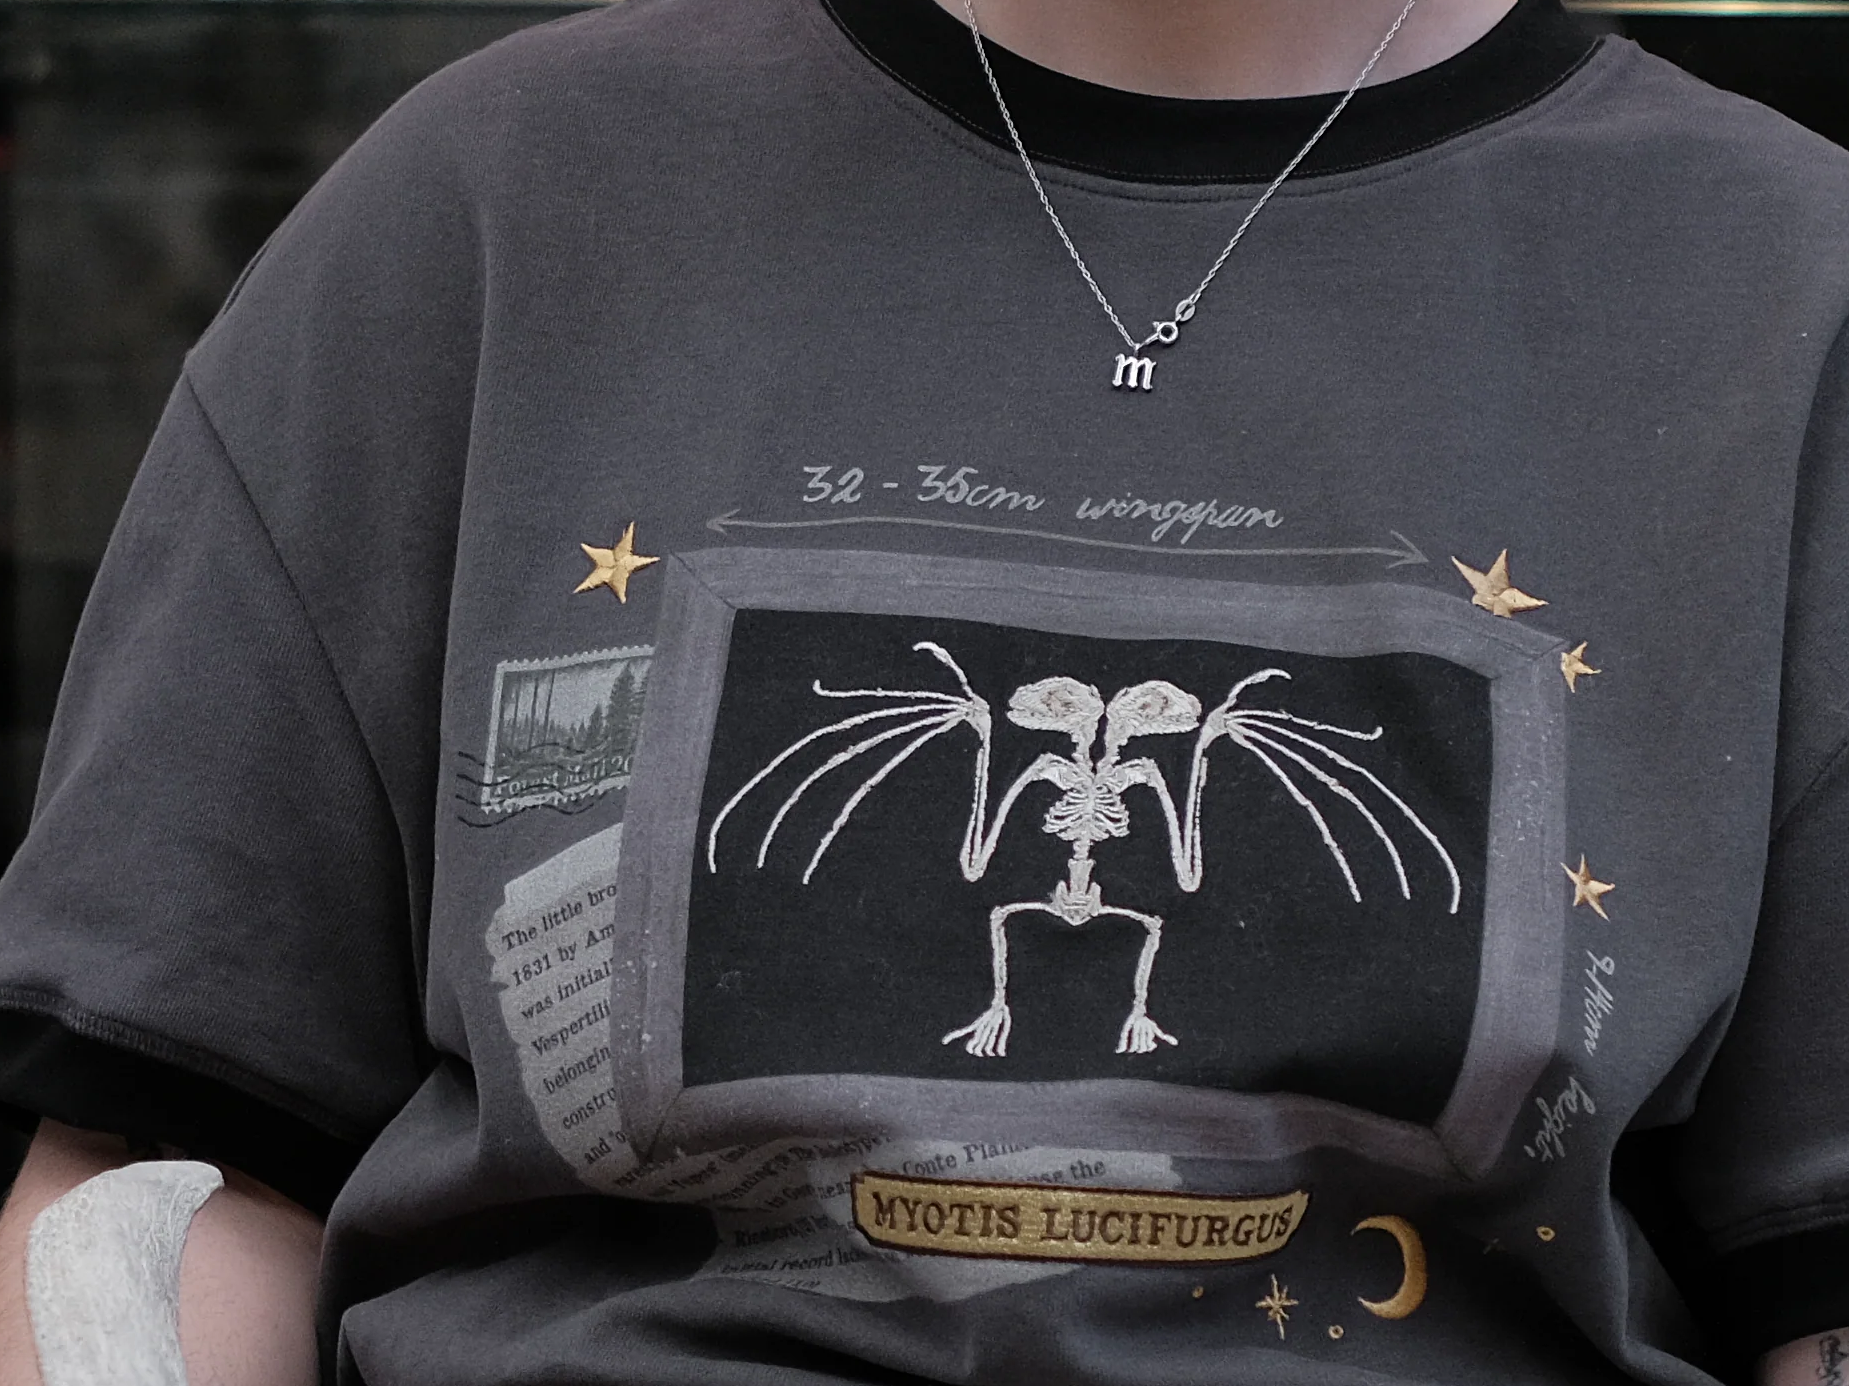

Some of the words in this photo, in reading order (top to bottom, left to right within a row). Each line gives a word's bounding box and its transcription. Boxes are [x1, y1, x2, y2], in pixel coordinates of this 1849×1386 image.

[802, 465, 865, 504] 32
[916, 464, 1050, 512] 35cm
[1075, 492, 1285, 545] wingspan
[501, 925, 538, 951] The
[542, 900, 583, 932] little
[587, 883, 617, 907] bro
[512, 953, 552, 987] 1831
[557, 941, 577, 962] by
[585, 923, 615, 949] Am
[520, 995, 553, 1020] was
[557, 958, 614, 1002] initial
[530, 998, 611, 1057] Vespertili
[542, 1045, 612, 1095] belongin
[583, 1136, 612, 1165] and
[902, 1151, 957, 1176] Conte
[1069, 1159, 1105, 1183] the
[871, 1192, 1021, 1240] MYOTIS
[1040, 1203, 1295, 1249] LUCIFURGUS
